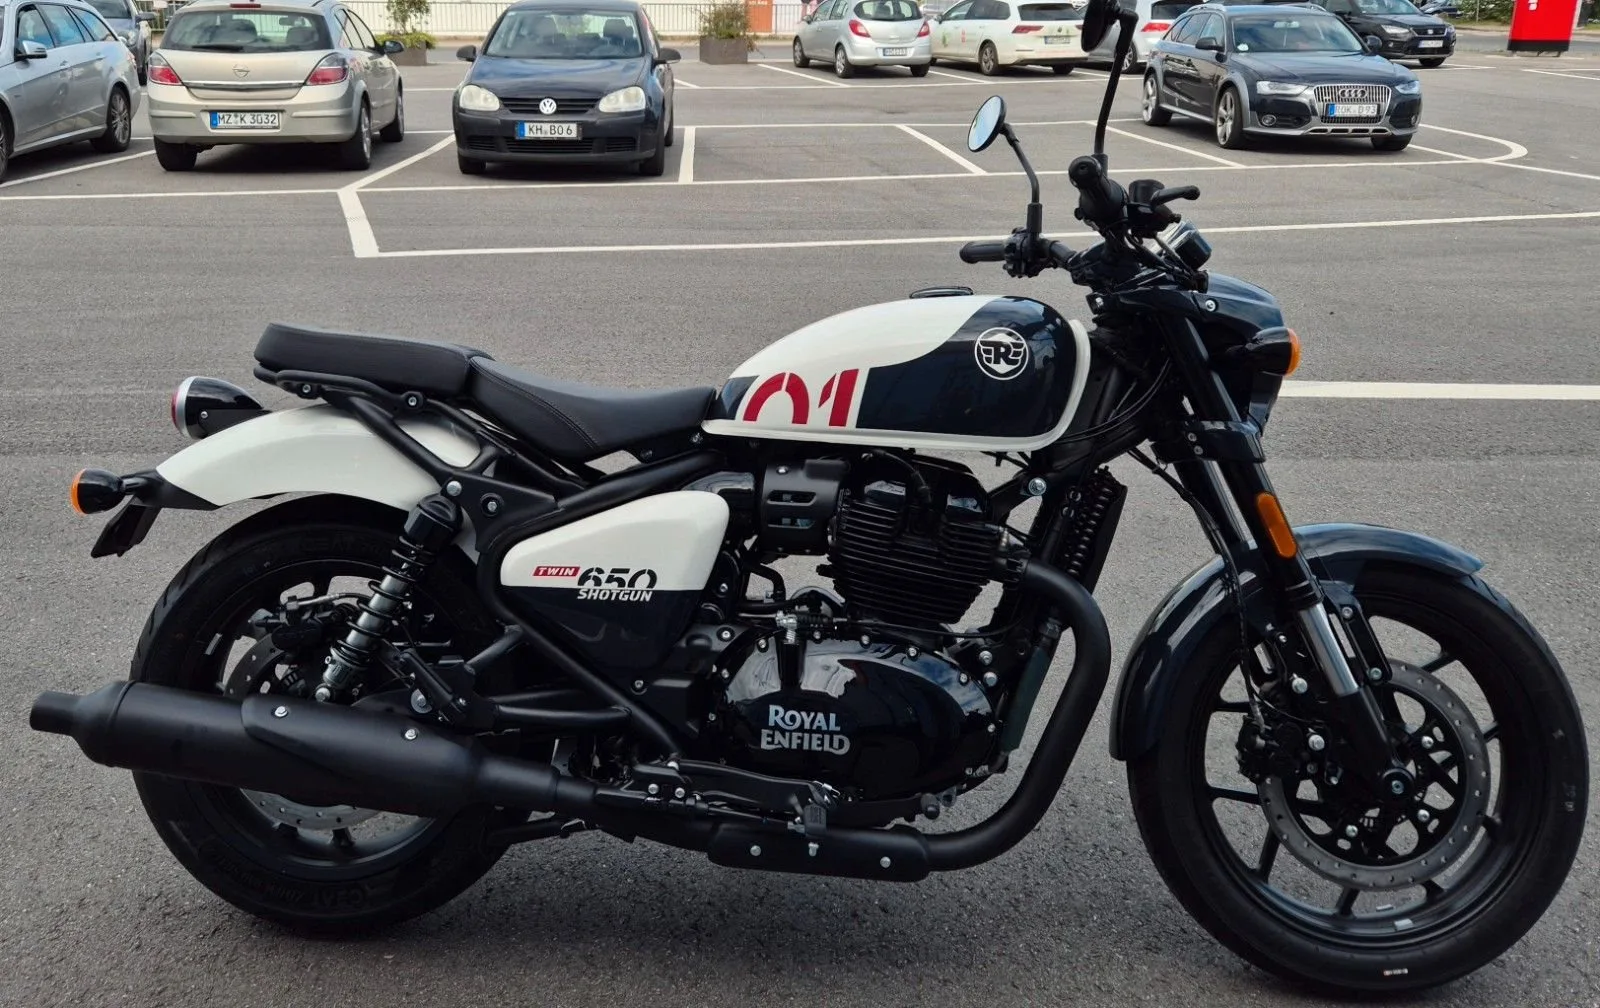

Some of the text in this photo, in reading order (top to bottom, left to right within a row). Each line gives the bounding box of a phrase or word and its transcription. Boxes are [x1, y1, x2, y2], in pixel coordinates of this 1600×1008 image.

[218, 113, 277, 125] MZ K 3032
[528, 124, 543, 135] KH
[566, 124, 573, 135] 6
[742, 368, 860, 428] 01
[538, 566, 658, 589] TWIN 650
[577, 588, 653, 602] SHOTGUN
[768, 704, 841, 731] ROYAL
[760, 728, 851, 755] ENFIELD
